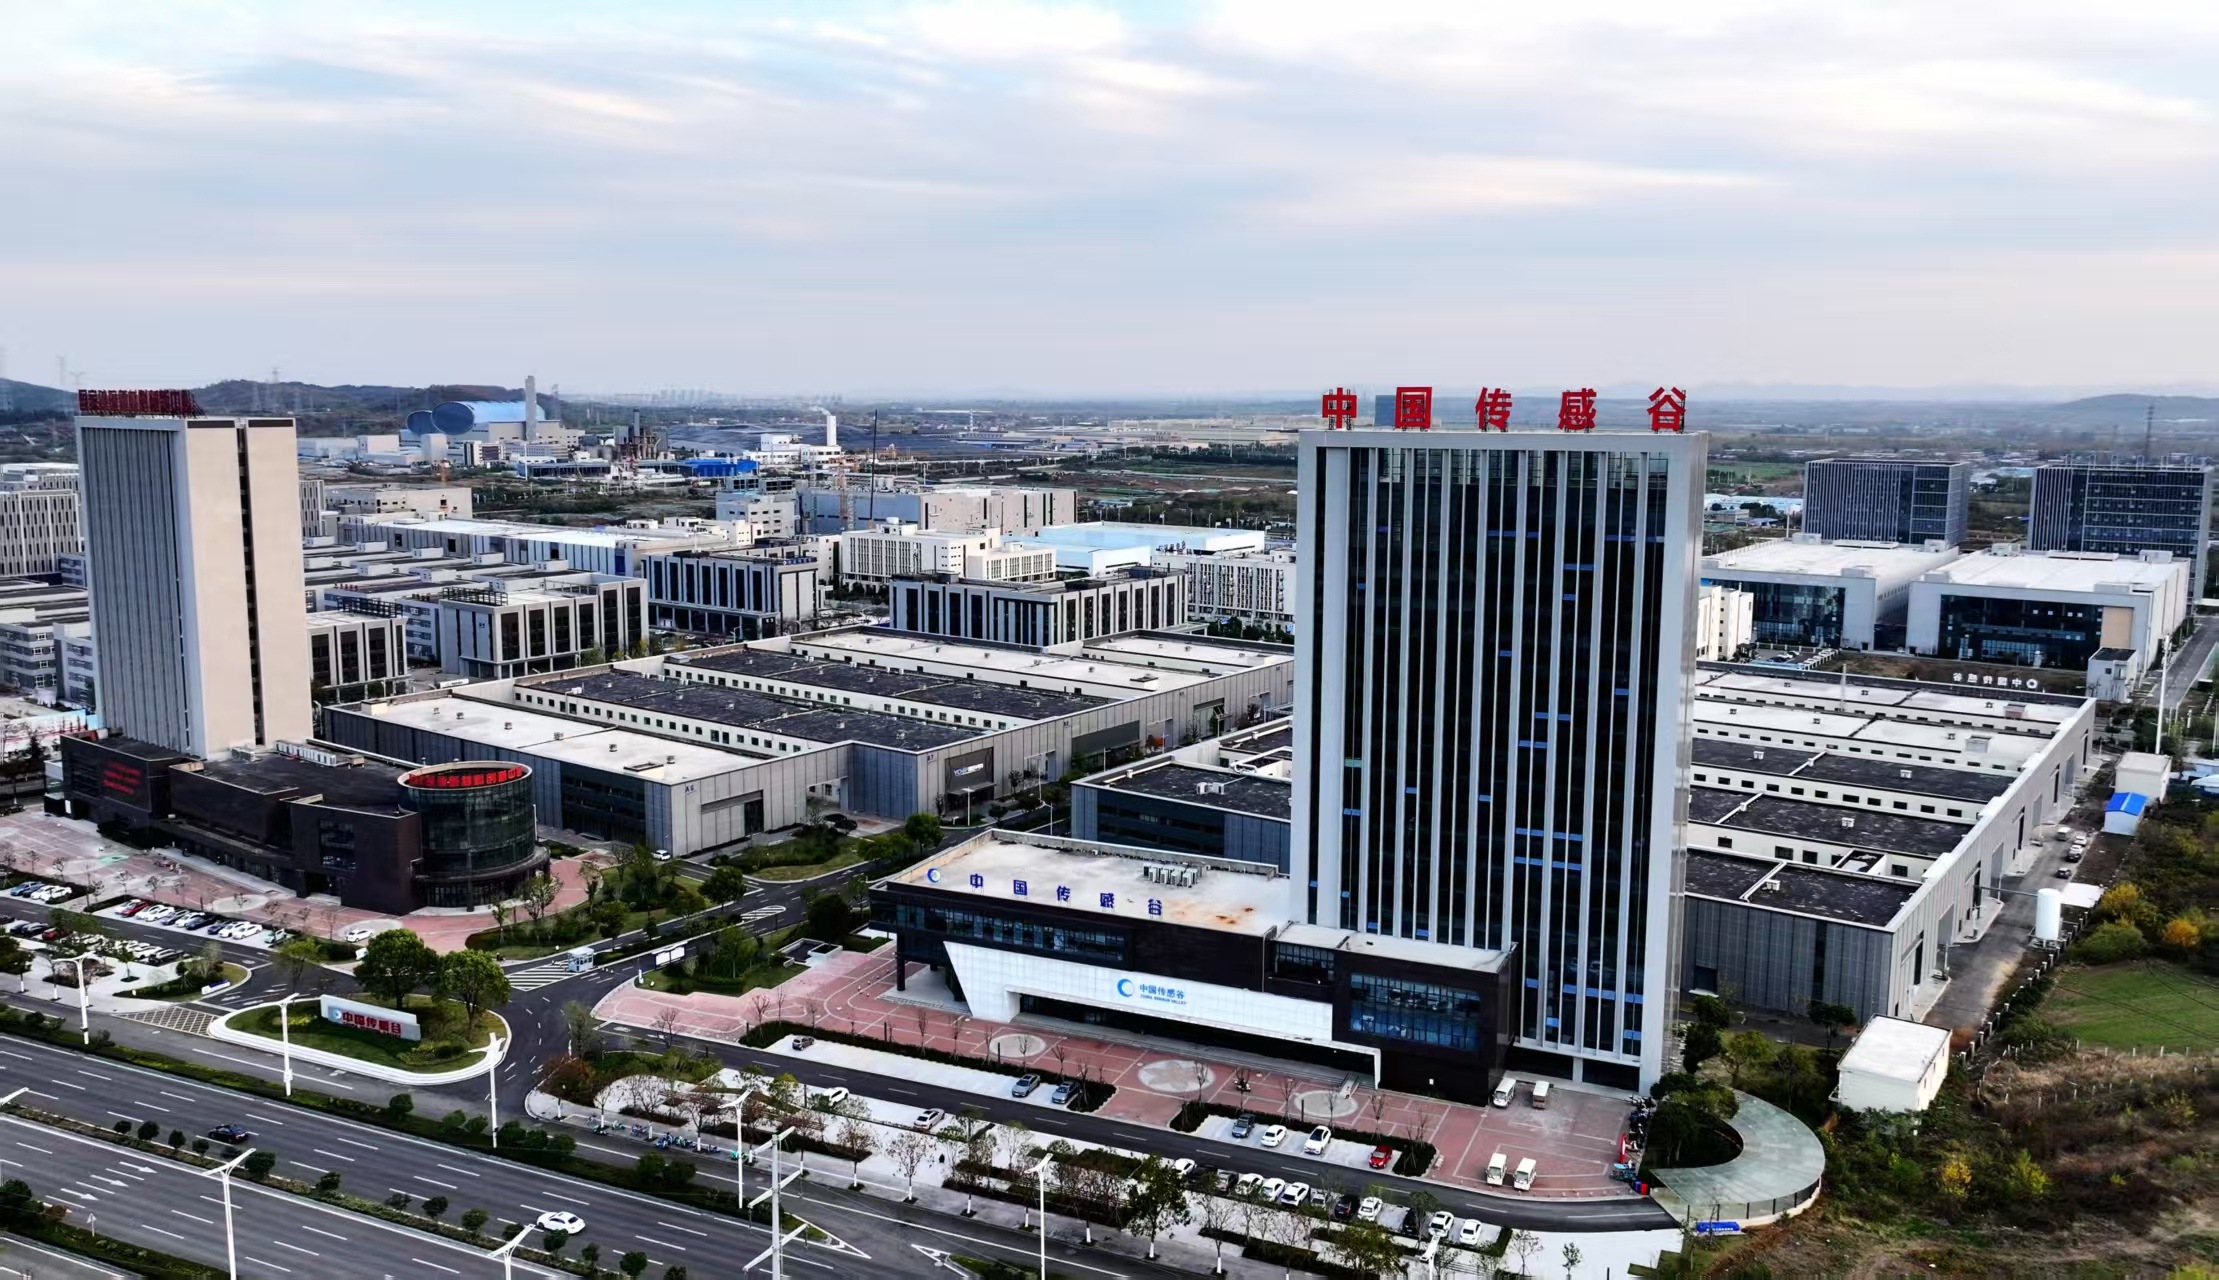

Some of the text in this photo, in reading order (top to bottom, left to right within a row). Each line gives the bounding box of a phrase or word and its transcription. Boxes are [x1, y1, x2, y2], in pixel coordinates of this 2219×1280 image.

[1322, 387, 1686, 431] 中国传感谷
[969, 873, 1163, 916] 中国传感谷
[1140, 984, 1185, 999] 中国传感谷
